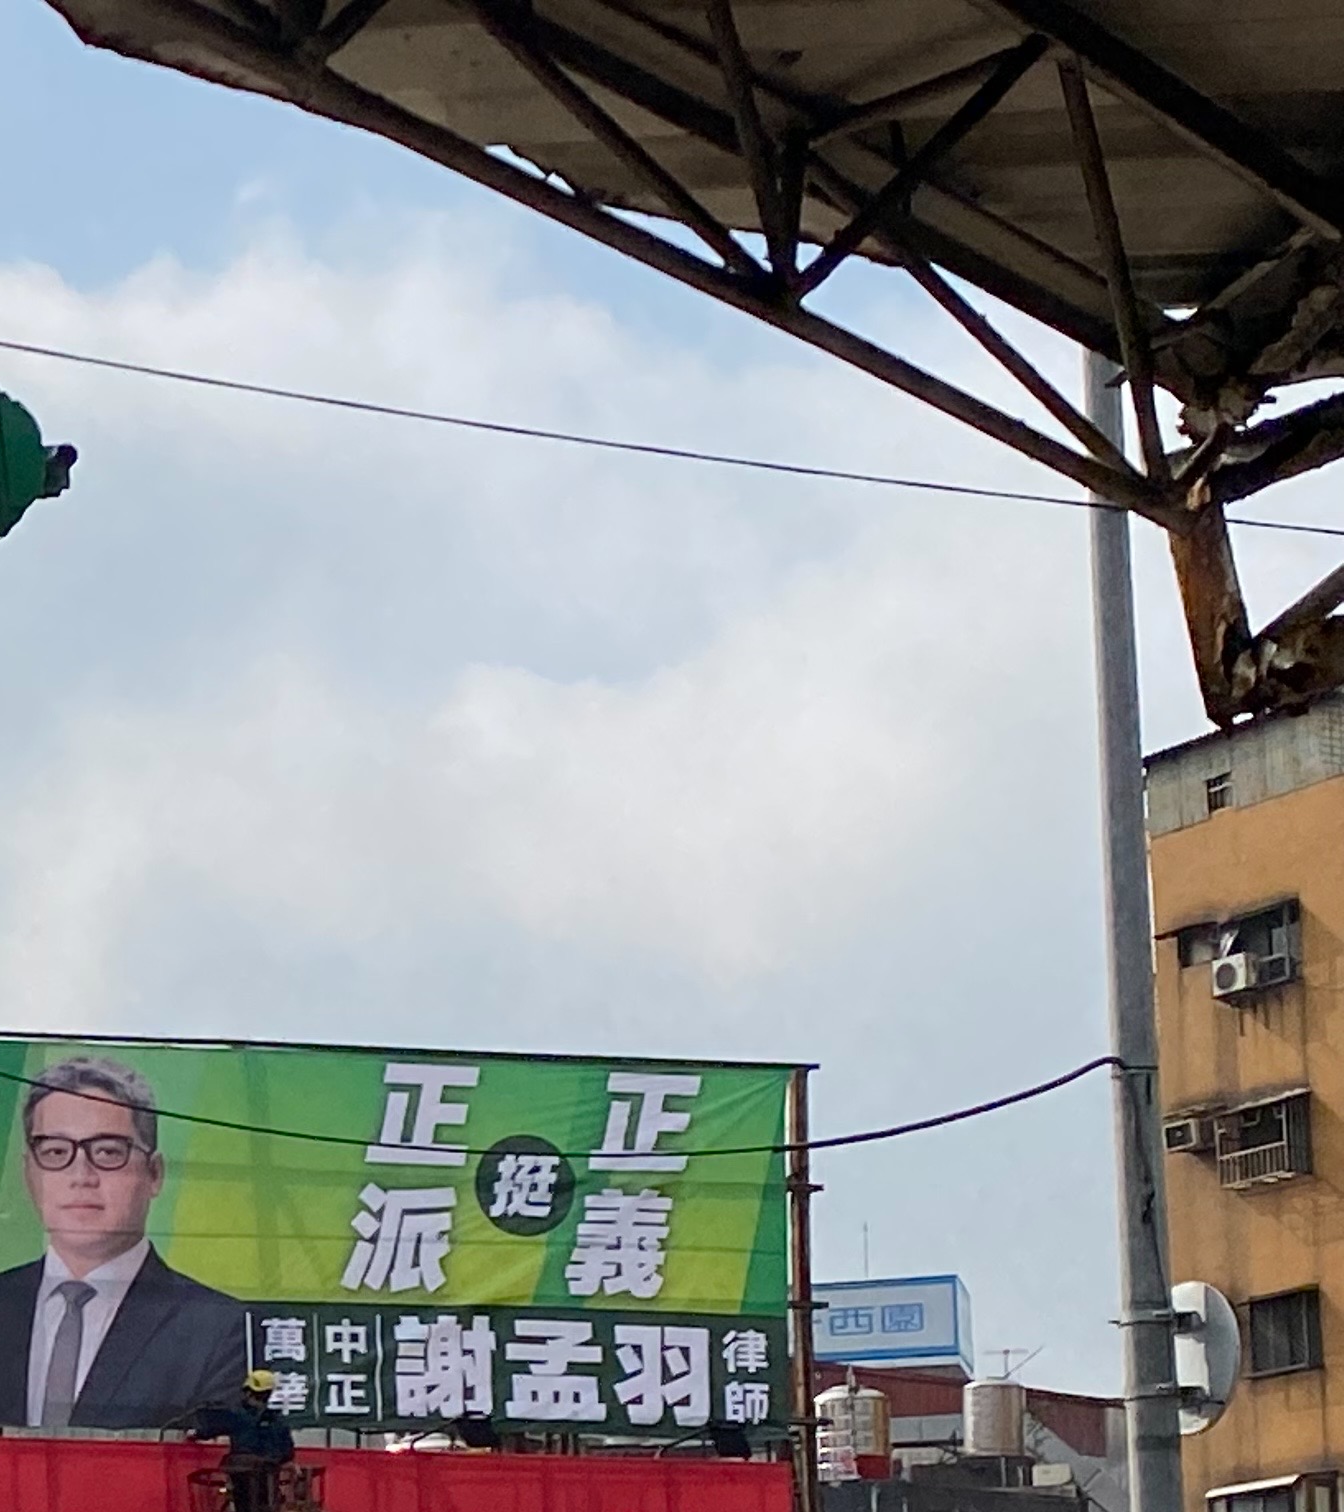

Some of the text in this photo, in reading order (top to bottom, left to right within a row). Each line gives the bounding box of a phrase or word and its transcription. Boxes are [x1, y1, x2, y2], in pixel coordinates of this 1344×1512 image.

[489, 1153, 561, 1219] 挺
[324, 1318, 371, 1415] 中正
[829, 1302, 924, 1335] 西園
[261, 1318, 310, 1417] 萬華
[394, 1314, 711, 1426] 謝孟羽
[722, 1328, 771, 1425] 律師
